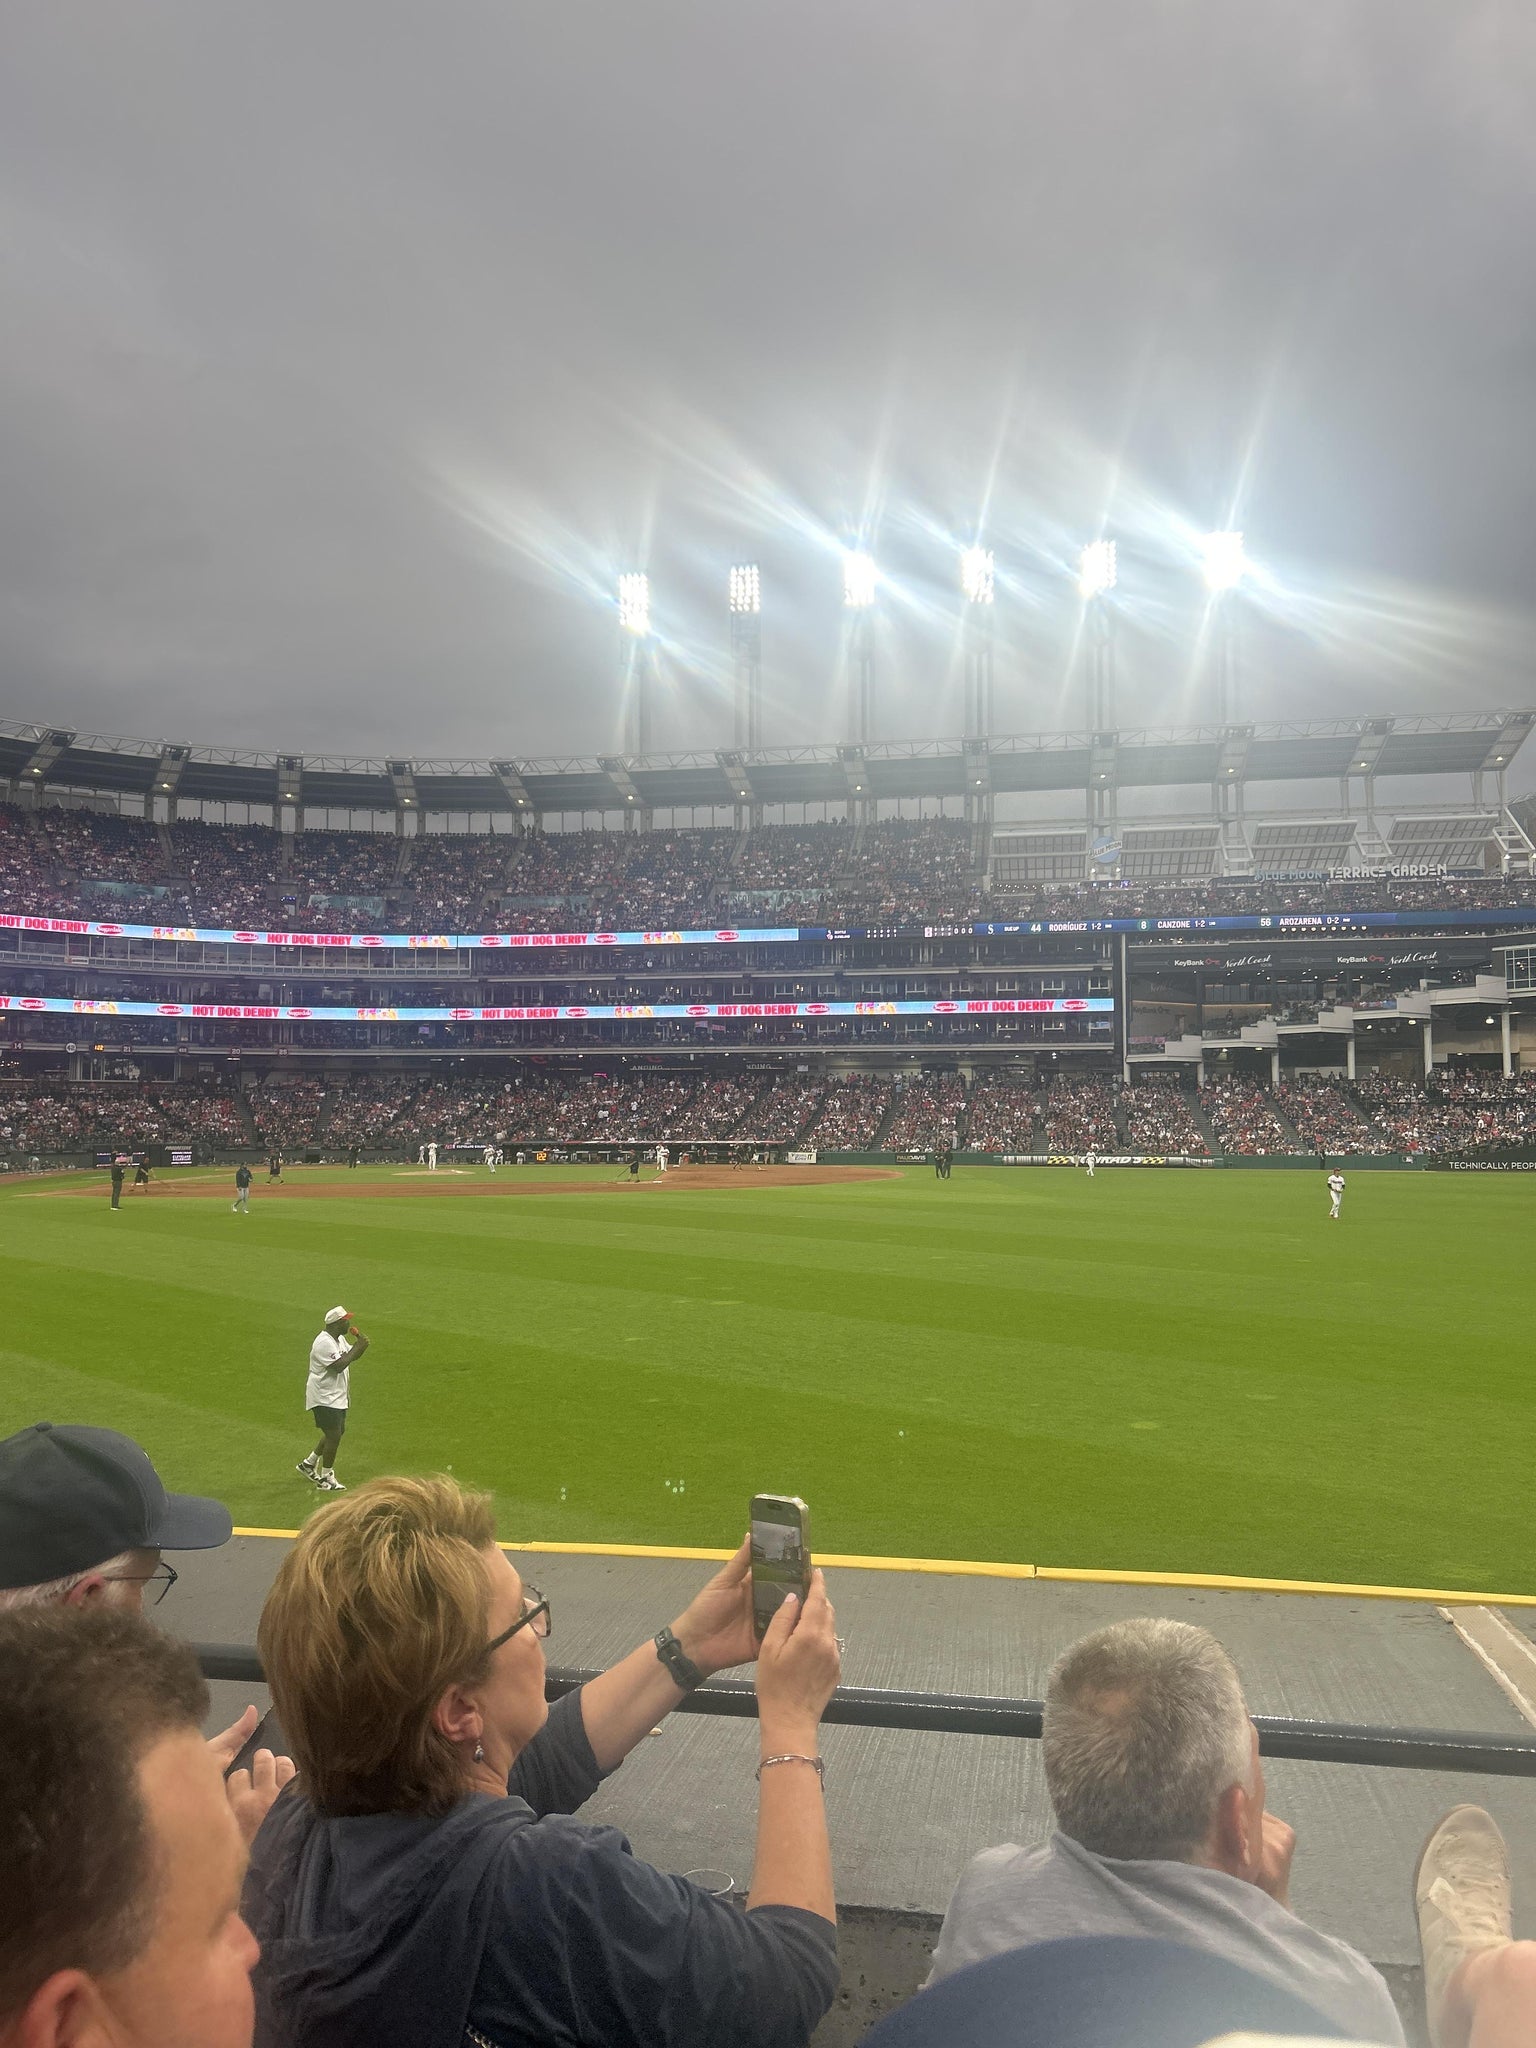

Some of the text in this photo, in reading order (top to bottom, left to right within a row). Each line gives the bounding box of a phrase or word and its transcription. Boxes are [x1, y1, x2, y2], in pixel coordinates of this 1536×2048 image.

[1254, 863, 1447, 882] BLUE MOON TERRACE GARDEN
[25, 918, 49, 930] DOG
[52, 920, 89, 933] DERBY
[1030, 923, 1041, 933] 44
[1048, 922, 1088, 932] RODRÍGUEZ
[1140, 920, 1147, 930] 8
[1157, 920, 1190, 929] CANZONE
[1195, 919, 1206, 928] 1-2
[1260, 918, 1271, 927] 56
[1279, 917, 1323, 926] AROZARENA
[1326, 916, 1339, 925] 0-2
[267, 933, 353, 945] HOT DOG DERBY
[510, 934, 588, 946] HOT DOG DERBY
[1174, 959, 1204, 967] KeyBank
[1337, 956, 1368, 964] KeyBank
[192, 1005, 280, 1018] HOT DOG DERBY
[717, 1005, 798, 1016] HOT DOG DERBY
[967, 1001, 1055, 1012] HOT DOG DERBY
[482, 1008, 559, 1019] HOT DOG DERBY
[13, 1042, 22, 1050] 14
[1449, 1161, 1536, 1170] TECHNICALLY, PEOP
